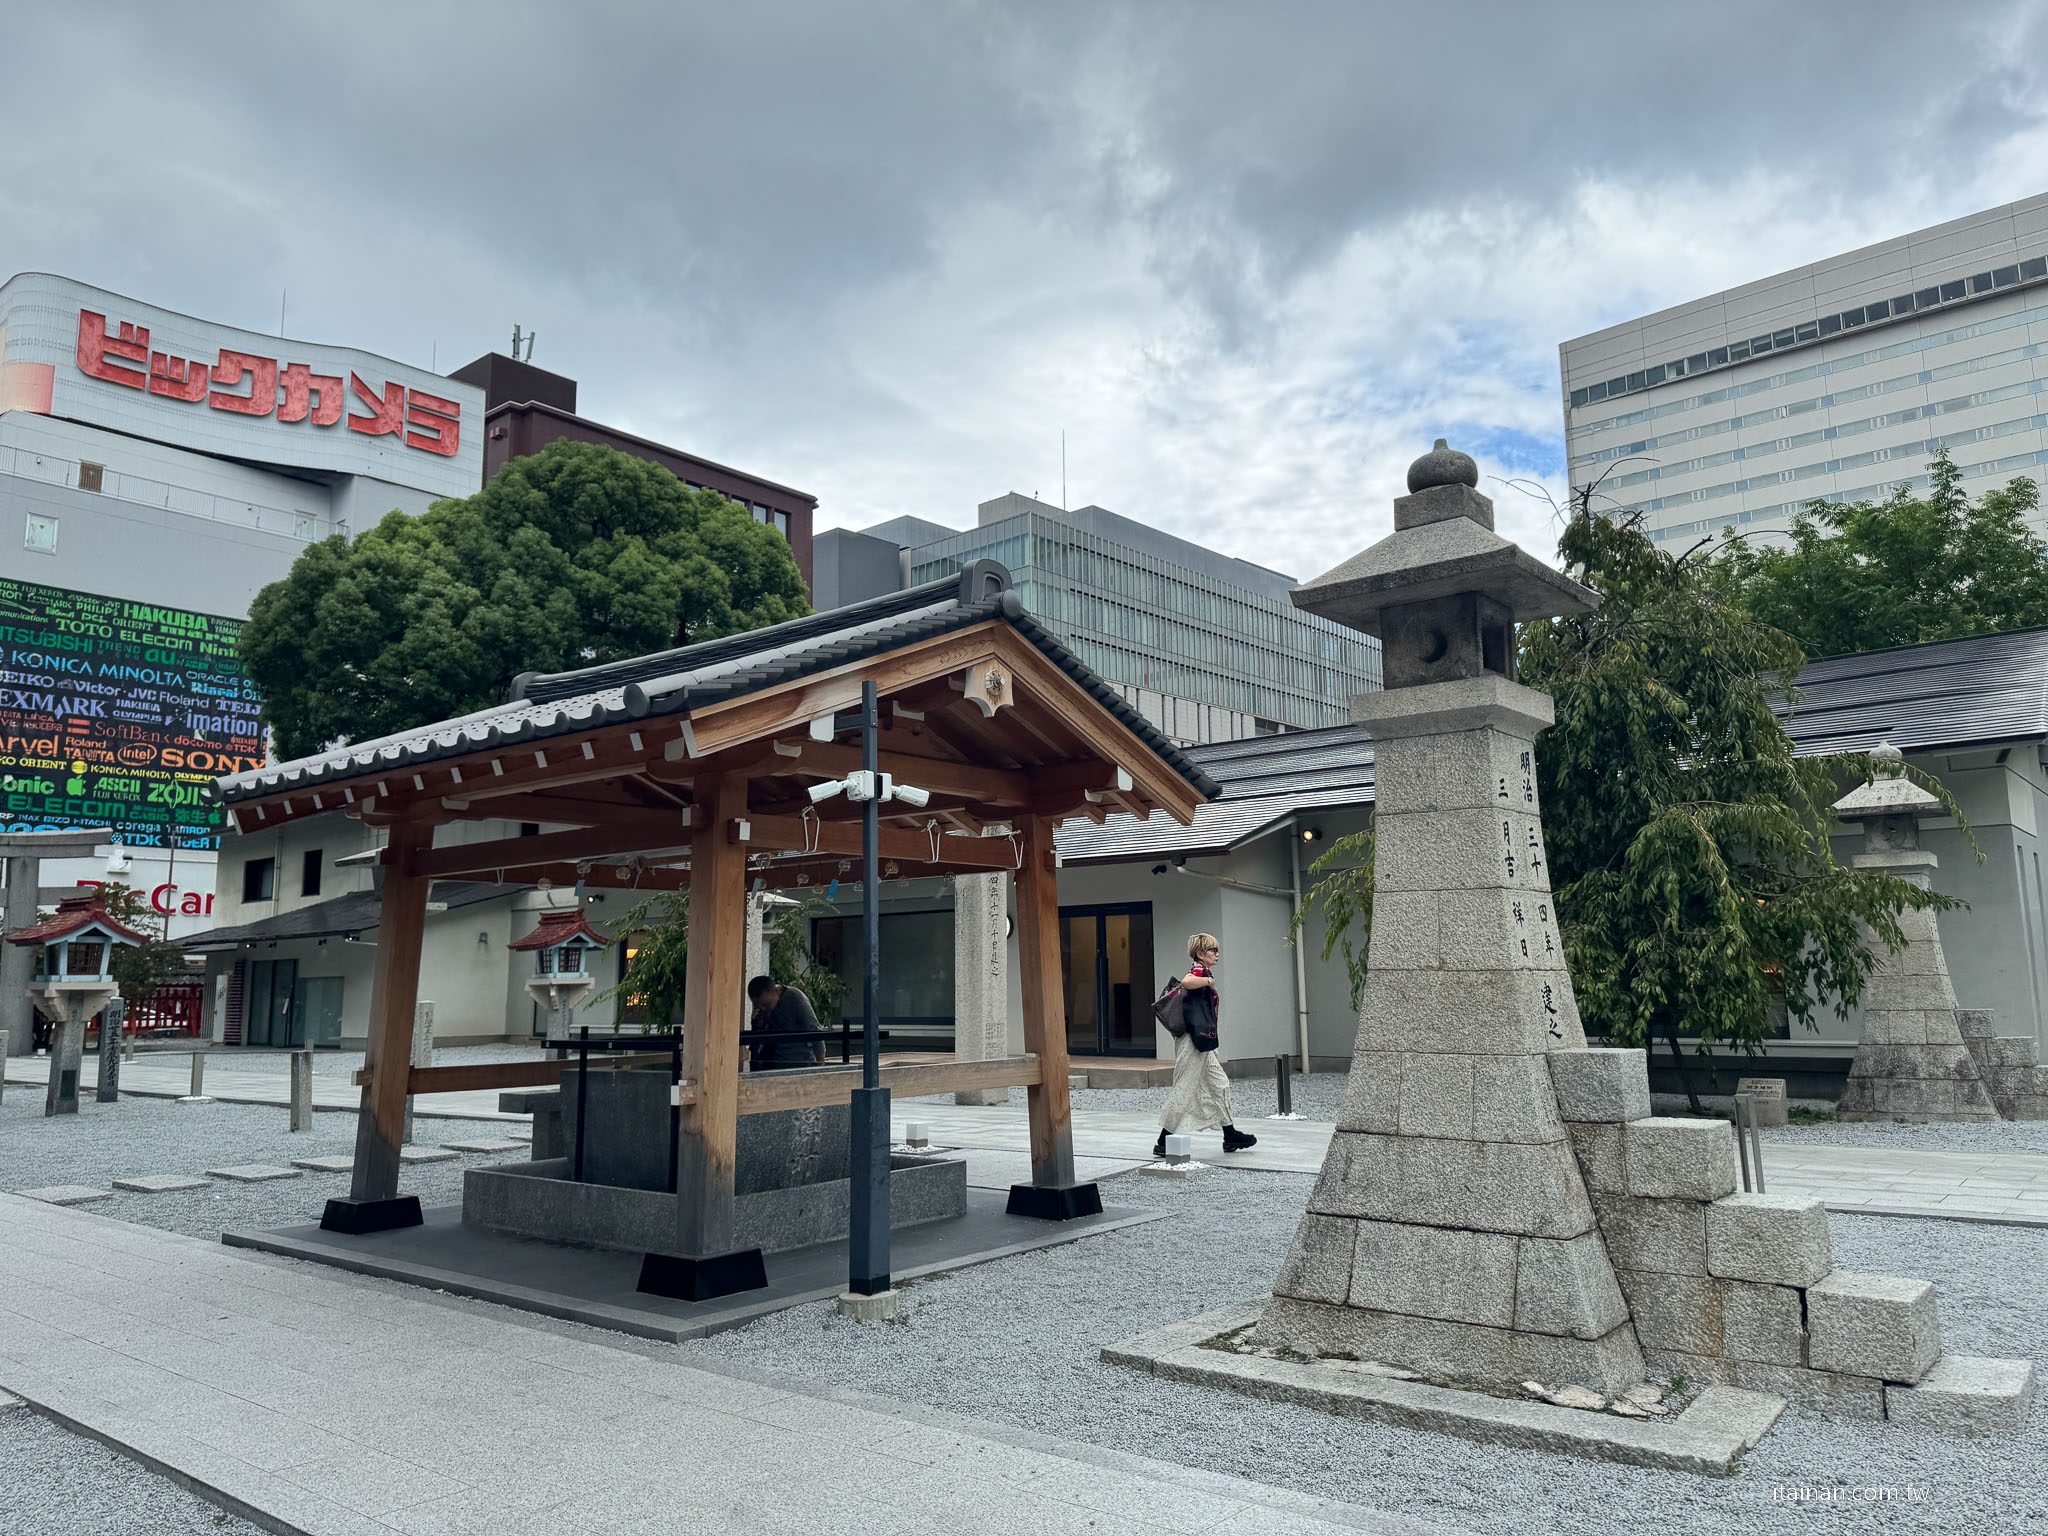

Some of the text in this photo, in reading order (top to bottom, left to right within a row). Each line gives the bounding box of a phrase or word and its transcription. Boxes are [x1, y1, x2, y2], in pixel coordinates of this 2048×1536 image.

[77, 308, 461, 457] ビックカメラ
[0, 581, 18, 591] TAX
[123, 602, 209, 632] HAKUBA
[55, 618, 113, 638] TOTO
[144, 648, 176, 665] au
[12, 650, 183, 687] KONICA MINOLTA
[73, 679, 158, 701] Victor JVC
[94, 721, 170, 744] SoftBank
[185, 708, 259, 737] imation
[65, 736, 107, 750] Roland
[19, 757, 67, 770] ORIENT
[90, 764, 129, 776] KONICA
[160, 747, 267, 774] SONY
[73, 818, 111, 827] HITACHI
[124, 832, 162, 847] TDK
